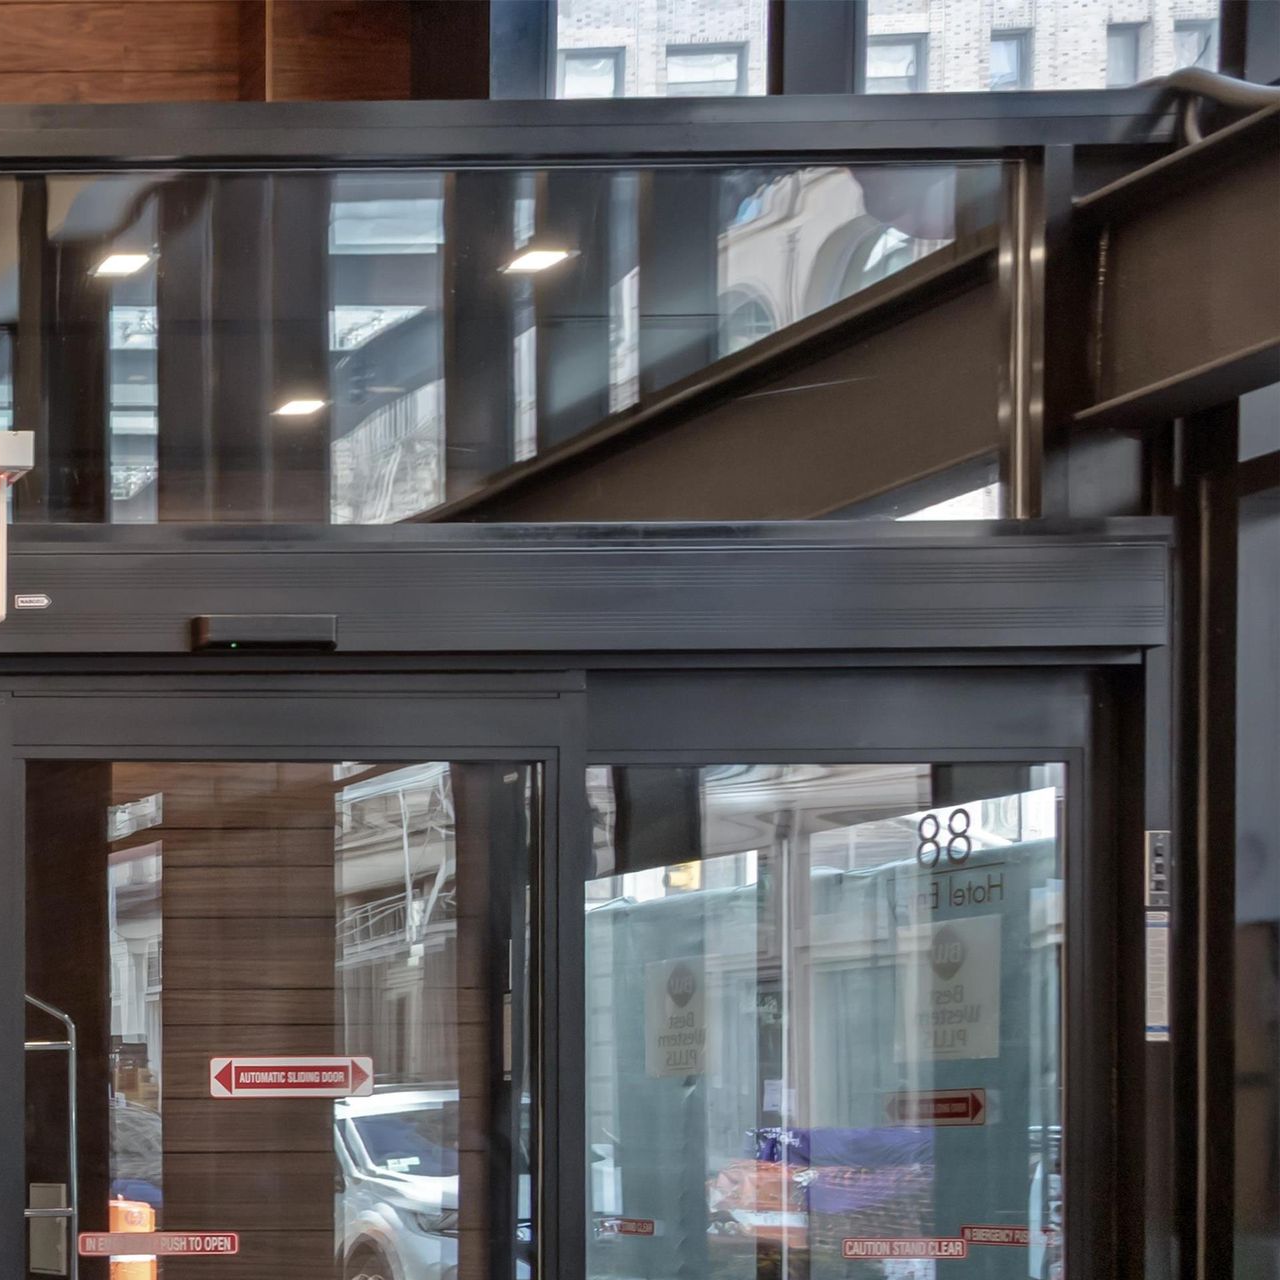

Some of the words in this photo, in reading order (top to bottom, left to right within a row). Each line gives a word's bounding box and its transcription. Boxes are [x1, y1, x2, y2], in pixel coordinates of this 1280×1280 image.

[240, 1072, 285, 1083] AUTOMATIC
[288, 1072, 320, 1082] SLIDING
[322, 1071, 344, 1082] DOOR
[973, 1229, 1012, 1241] EMERGENCY
[1014, 1230, 1028, 1241] PUS
[86, 1238, 96, 1250] IN
[160, 1237, 186, 1250] PUSH
[188, 1237, 202, 1250] TO
[204, 1237, 231, 1250] OPEN
[846, 1241, 890, 1255] CAUTION
[892, 1241, 925, 1255] STAND
[928, 1241, 962, 1255] CLEAR
